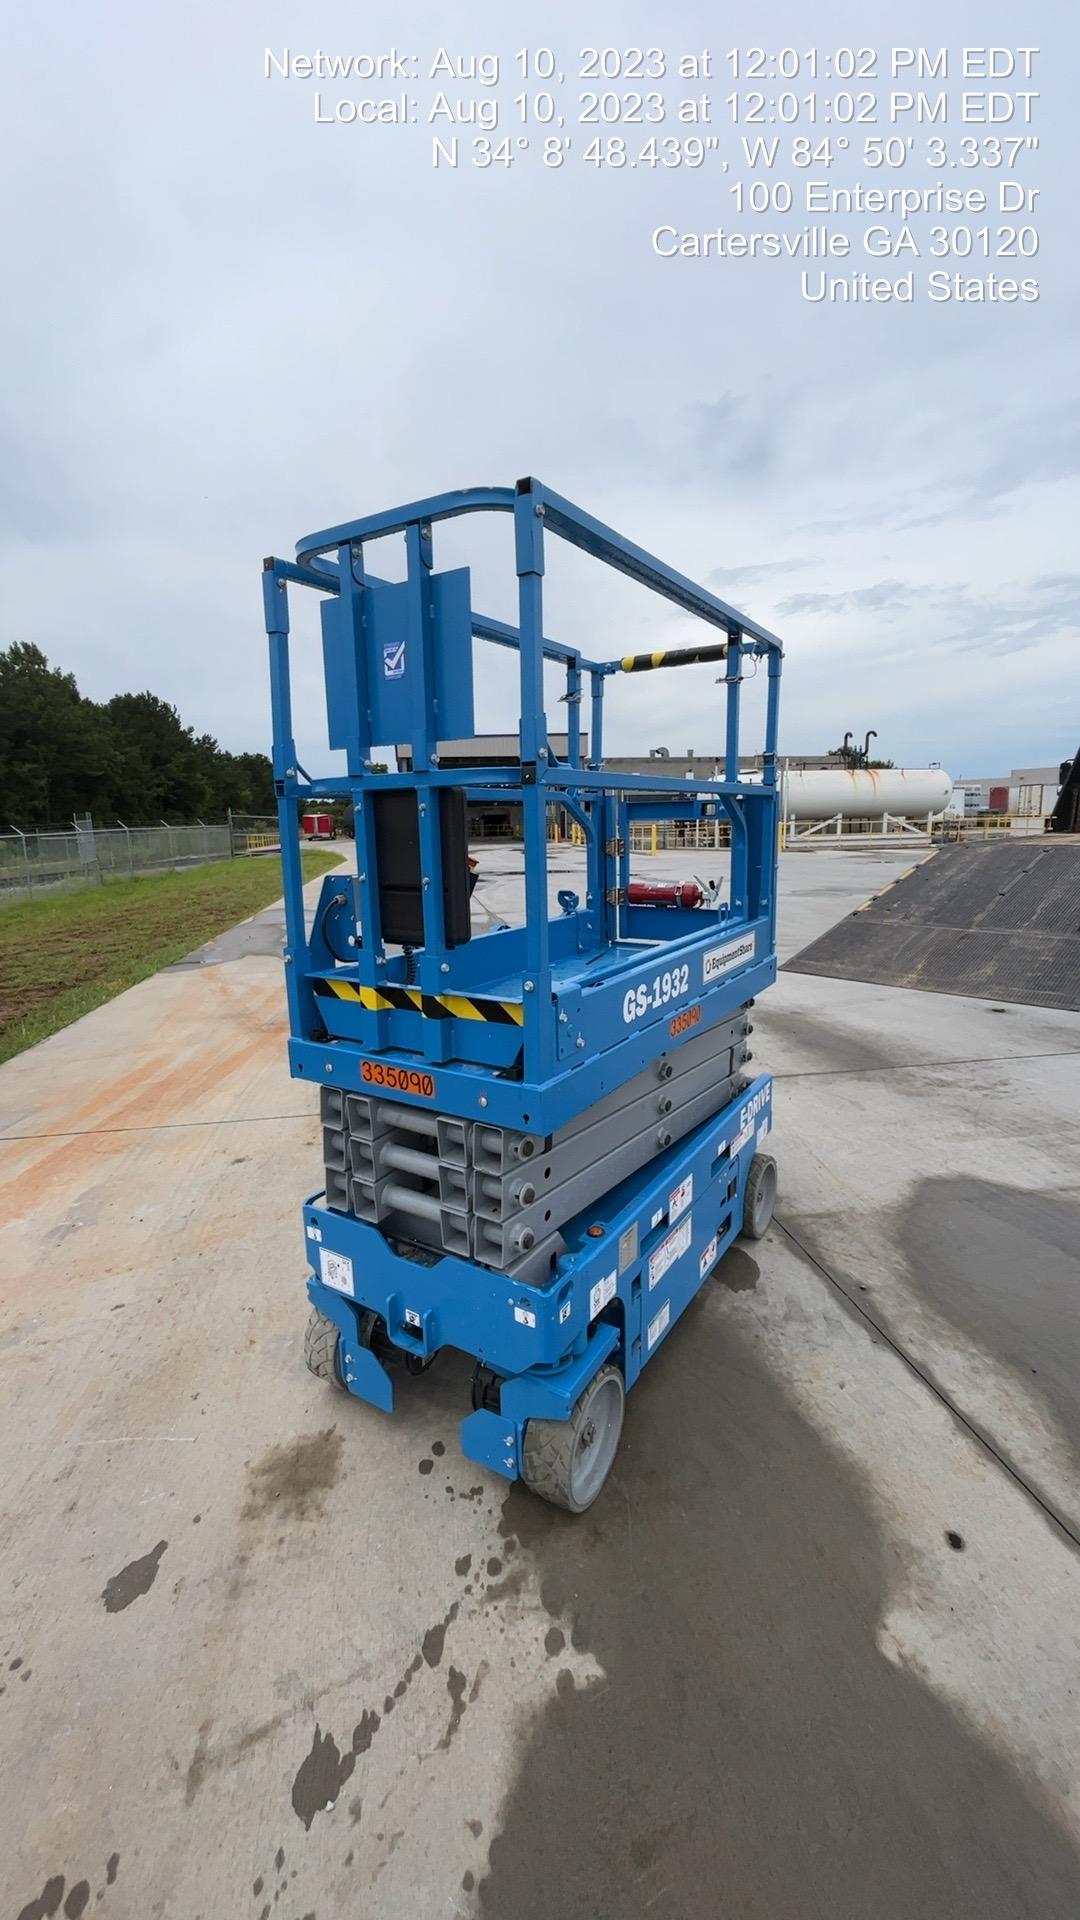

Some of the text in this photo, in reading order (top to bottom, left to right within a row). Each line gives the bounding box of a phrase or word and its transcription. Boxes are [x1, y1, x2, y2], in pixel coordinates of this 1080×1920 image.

[711, 942, 753, 971] EquipmentShare
[623, 964, 689, 1023] GS-1932
[361, 1060, 434, 1096] 335090
[740, 1081, 771, 1130] E-DRIVE
